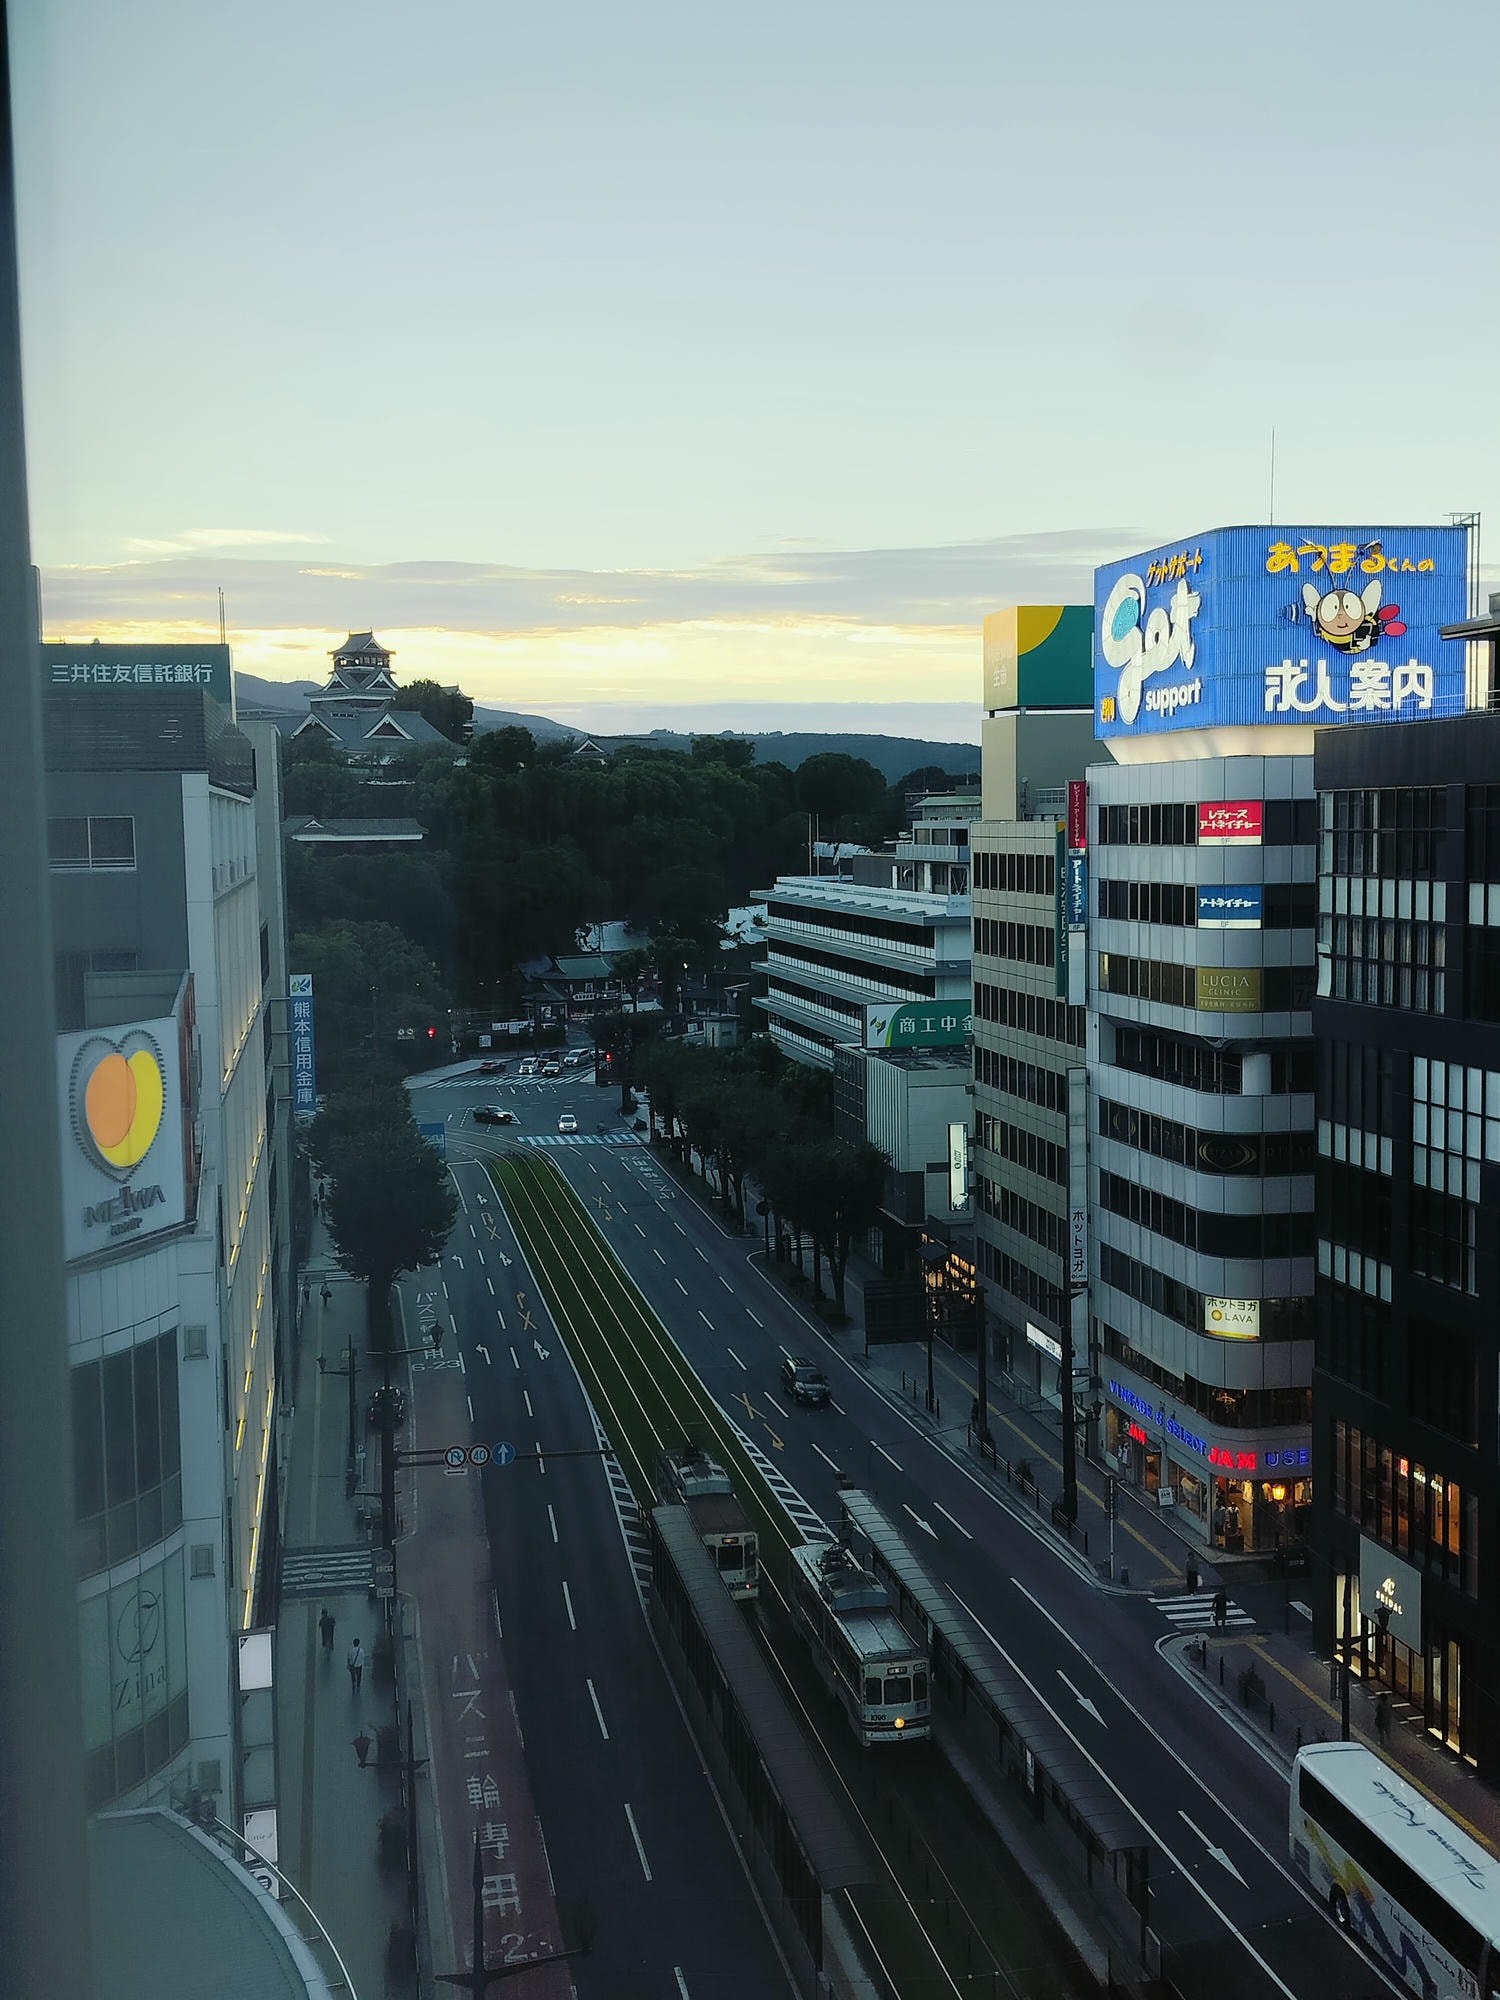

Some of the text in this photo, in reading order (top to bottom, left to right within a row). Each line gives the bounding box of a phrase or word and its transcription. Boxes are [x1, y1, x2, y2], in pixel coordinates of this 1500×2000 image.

[51, 664, 213, 683] 三井住友信託銀行
[1264, 658, 1433, 712] 求人案内
[1145, 678, 1201, 717] support
[1208, 809, 1248, 820] レディース
[1199, 820, 1261, 830] アートネイチャー
[1199, 897, 1259, 908] アートネイチャー
[1201, 975, 1249, 987] LUCIA
[1208, 988, 1241, 996] CLINIC
[899, 1015, 973, 1036] 商工中金
[292, 1002, 313, 1104] 熊本信用金庫
[1072, 1210, 1085, 1272] ホットヨガ
[1207, 1297, 1257, 1311] ホットヨガ
[1224, 1312, 1253, 1323] LAVA
[1109, 1379, 1153, 1420] VINTAGE
[1166, 1417, 1207, 1456] SELECT
[1207, 1446, 1257, 1470] JAM
[473, 1450, 486, 1461] 40
[1375, 1589, 1403, 1615] BRIDAL
